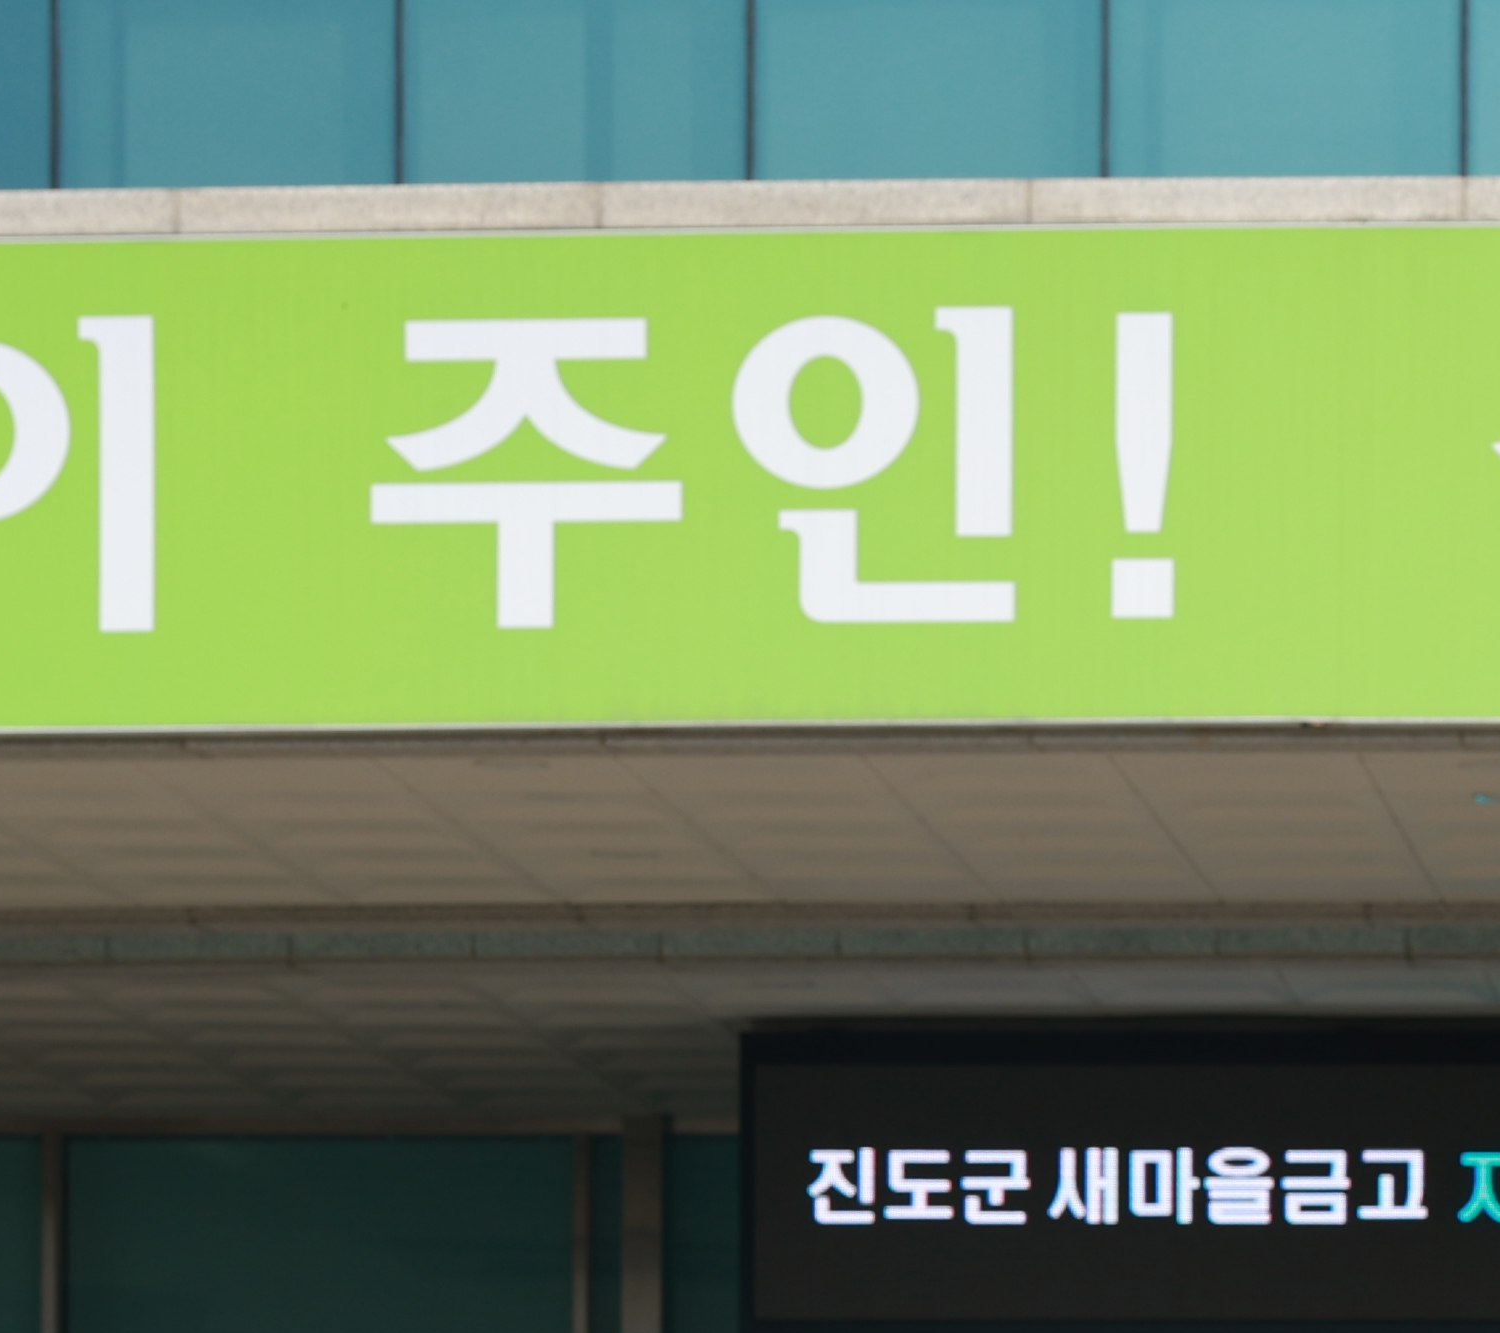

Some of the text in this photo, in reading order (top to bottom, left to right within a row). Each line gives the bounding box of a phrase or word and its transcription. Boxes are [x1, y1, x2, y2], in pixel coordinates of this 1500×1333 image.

[370, 305, 1173, 627] 주인!
[806, 1147, 1029, 1224] 진도군
[1048, 1147, 1428, 1224] 새마을금고
